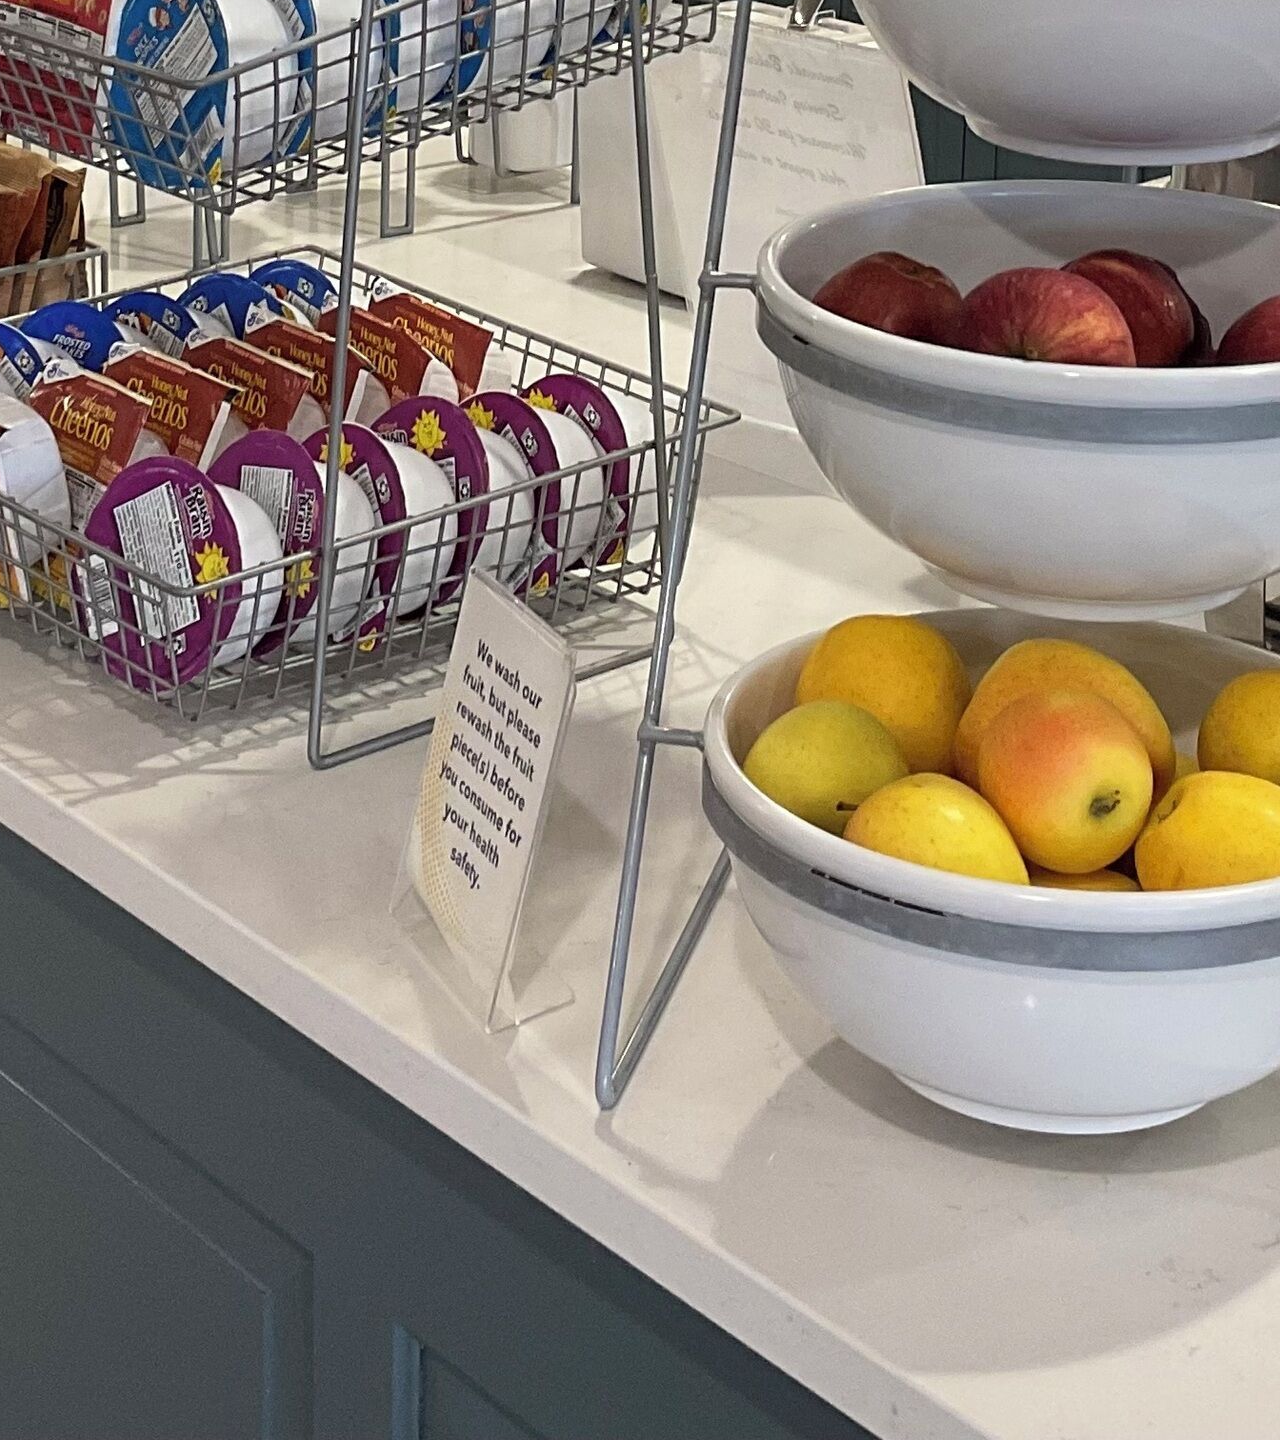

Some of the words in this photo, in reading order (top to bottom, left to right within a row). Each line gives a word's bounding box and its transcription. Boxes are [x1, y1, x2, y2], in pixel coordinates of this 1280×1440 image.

[53, 333, 91, 350] FROSTED
[57, 342, 86, 360] LAKES
[49, 396, 115, 451] Cheerios
[186, 497, 202, 537] Bran
[191, 485, 212, 538] Raisin
[294, 495, 307, 534] Bran
[302, 491, 315, 540] Raisin
[477, 638, 493, 668] We
[495, 659, 520, 692] wash
[522, 685, 542, 709] our
[463, 664, 486, 702] fruit,
[489, 685, 506, 718] but
[506, 708, 541, 748] please
[456, 701, 493, 742] rewash
[494, 731, 510, 759] the
[512, 746, 534, 782] fruit
[450, 733, 490, 781] piece(s)
[490, 764, 525, 811] before
[439, 759, 458, 787] you
[459, 780, 503, 831] consume
[504, 819, 522, 848] for
[442, 802, 468, 833] your
[469, 821, 499, 868] health
[450, 847, 480, 890] safety.
